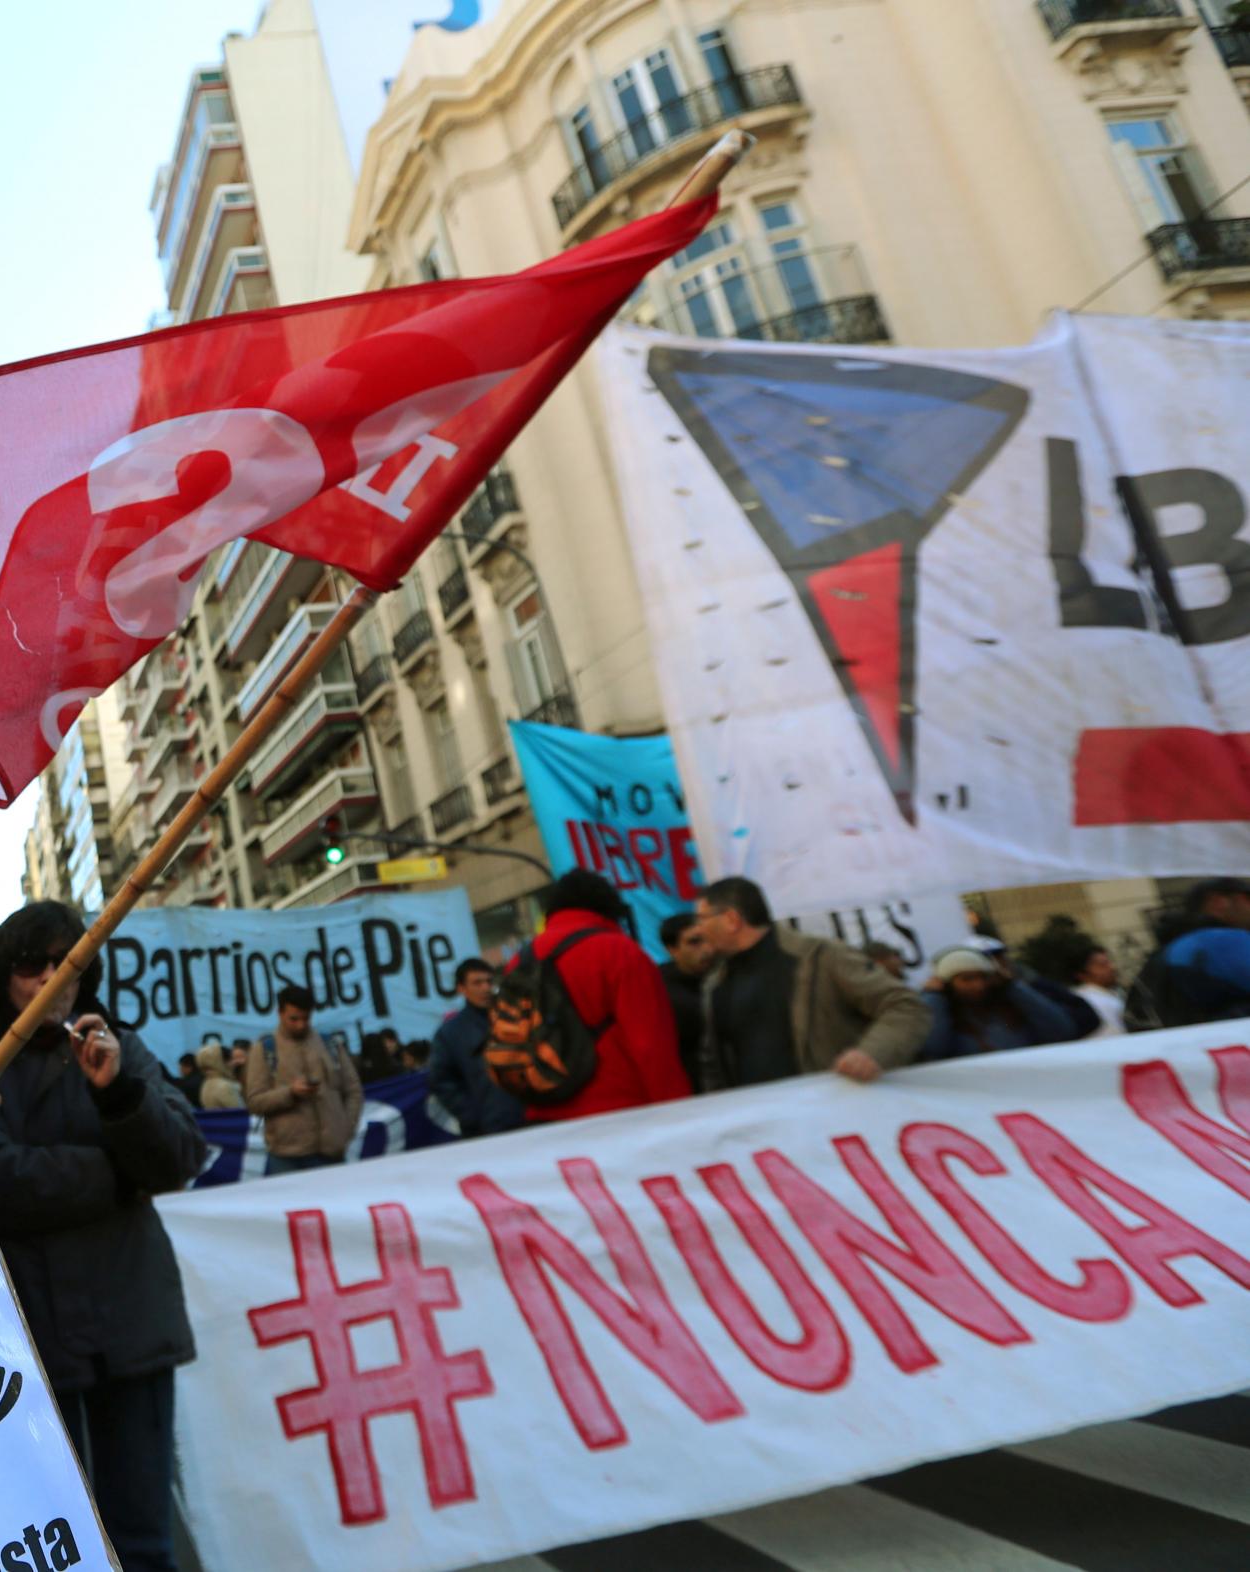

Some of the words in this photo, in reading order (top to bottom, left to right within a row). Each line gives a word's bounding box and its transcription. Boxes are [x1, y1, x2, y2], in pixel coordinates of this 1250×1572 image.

[107, 934, 300, 1030] Barrios
[304, 926, 362, 1010] de
[361, 918, 462, 1018] Pie
[248, 1111, 1250, 1527] #NUNCA
